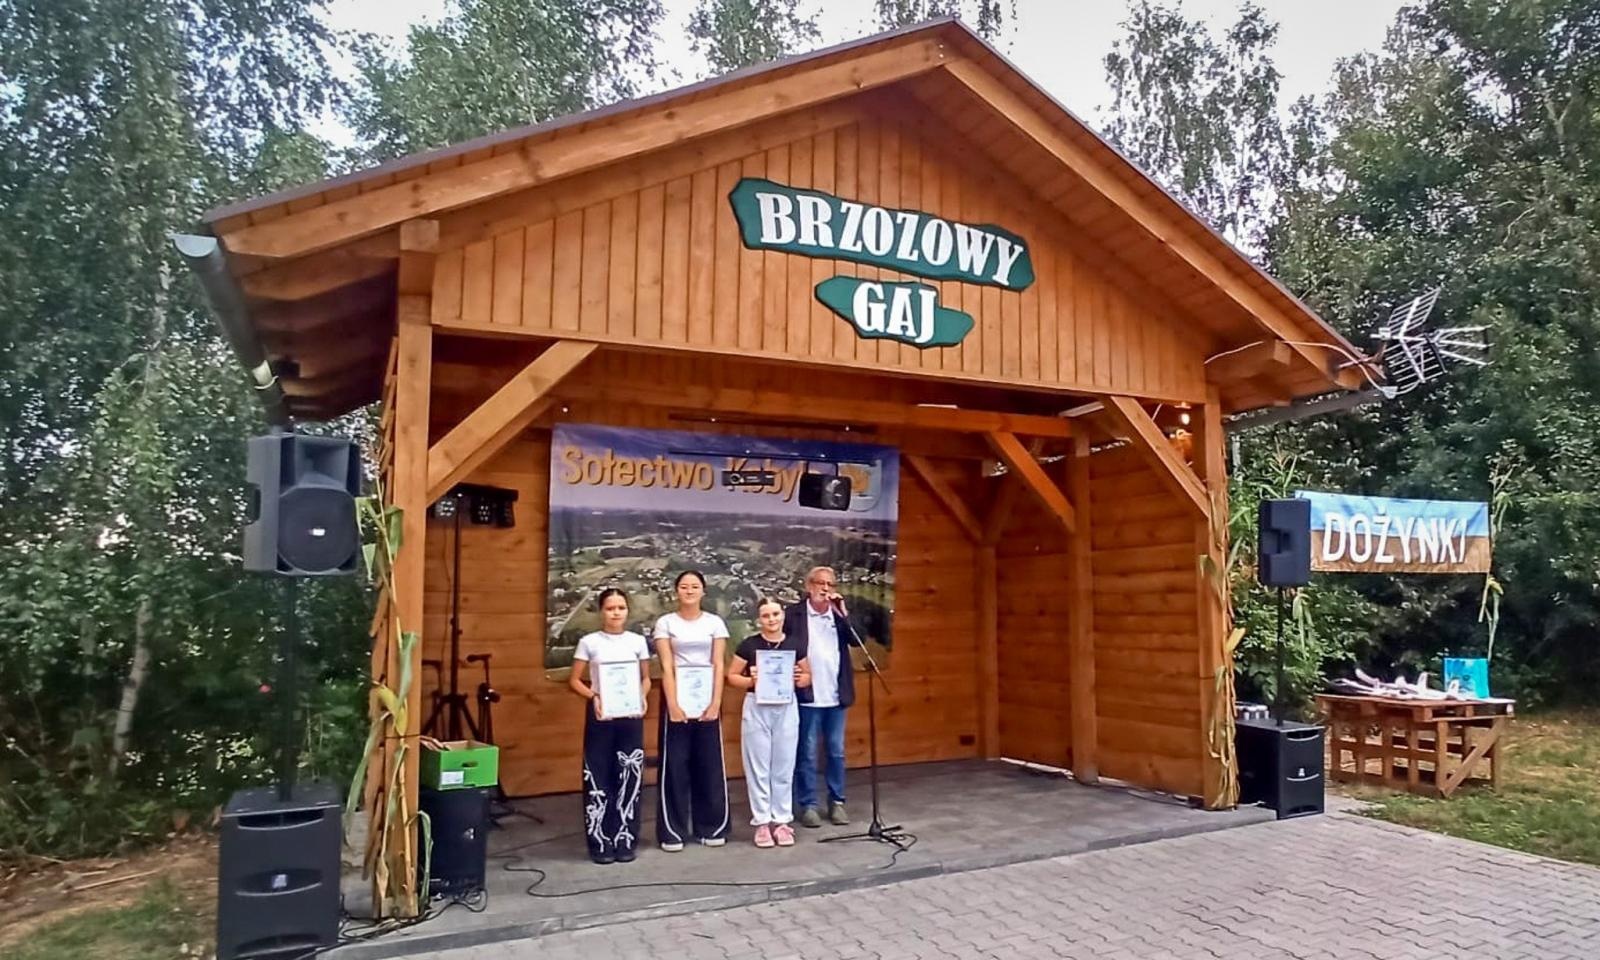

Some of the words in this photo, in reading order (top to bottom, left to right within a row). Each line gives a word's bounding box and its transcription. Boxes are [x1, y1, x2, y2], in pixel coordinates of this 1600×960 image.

[756, 192, 1023, 286] BRZOZOWY
[852, 282, 936, 343] GAJ
[563, 446, 715, 491] Sołectwo
[1322, 506, 1467, 564] DOŻYNKI
